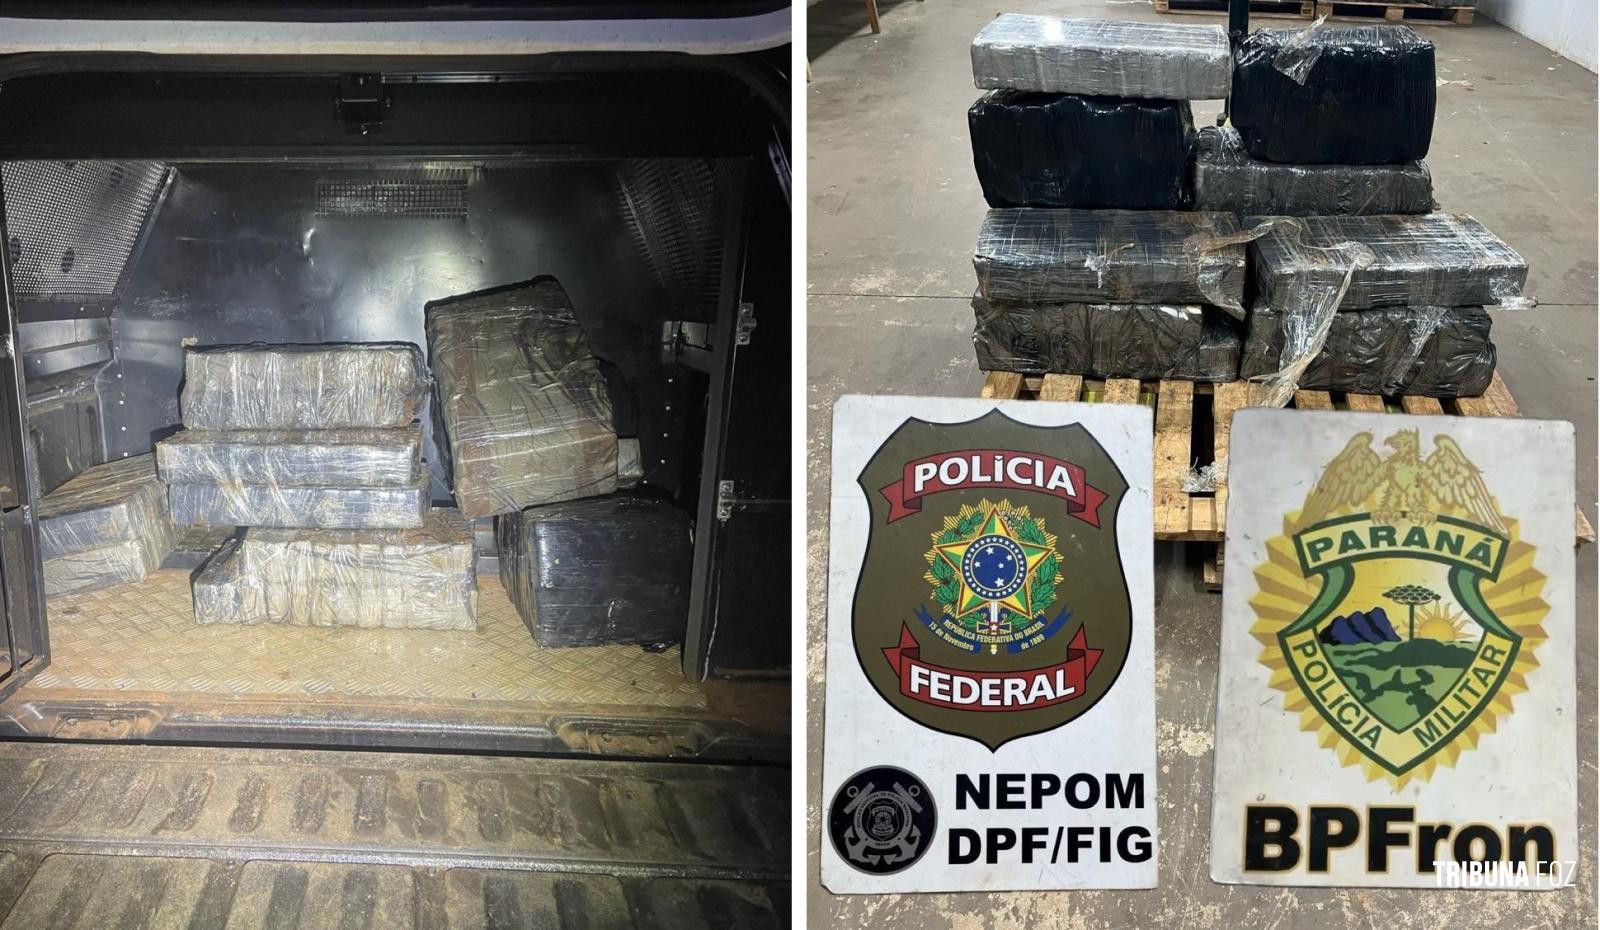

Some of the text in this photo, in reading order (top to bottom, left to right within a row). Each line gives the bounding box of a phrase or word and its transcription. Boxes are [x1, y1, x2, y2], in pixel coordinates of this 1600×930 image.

[1305, 525, 1495, 568] PARANÁ
[929, 621, 936, 631] 15
[935, 628, 944, 637] de
[943, 634, 974, 651] Novembro
[1021, 642, 1030, 650] de
[976, 634, 1014, 643] FEDERATIVA
[1024, 621, 1045, 636] BRASIL
[910, 664, 1076, 707] FEDERAL
[1412, 642, 1507, 748] MILITAR
[955, 772, 1146, 810] NEPOM
[948, 825, 1154, 866] DPF/FIG
[1243, 803, 1559, 874] BPFron
